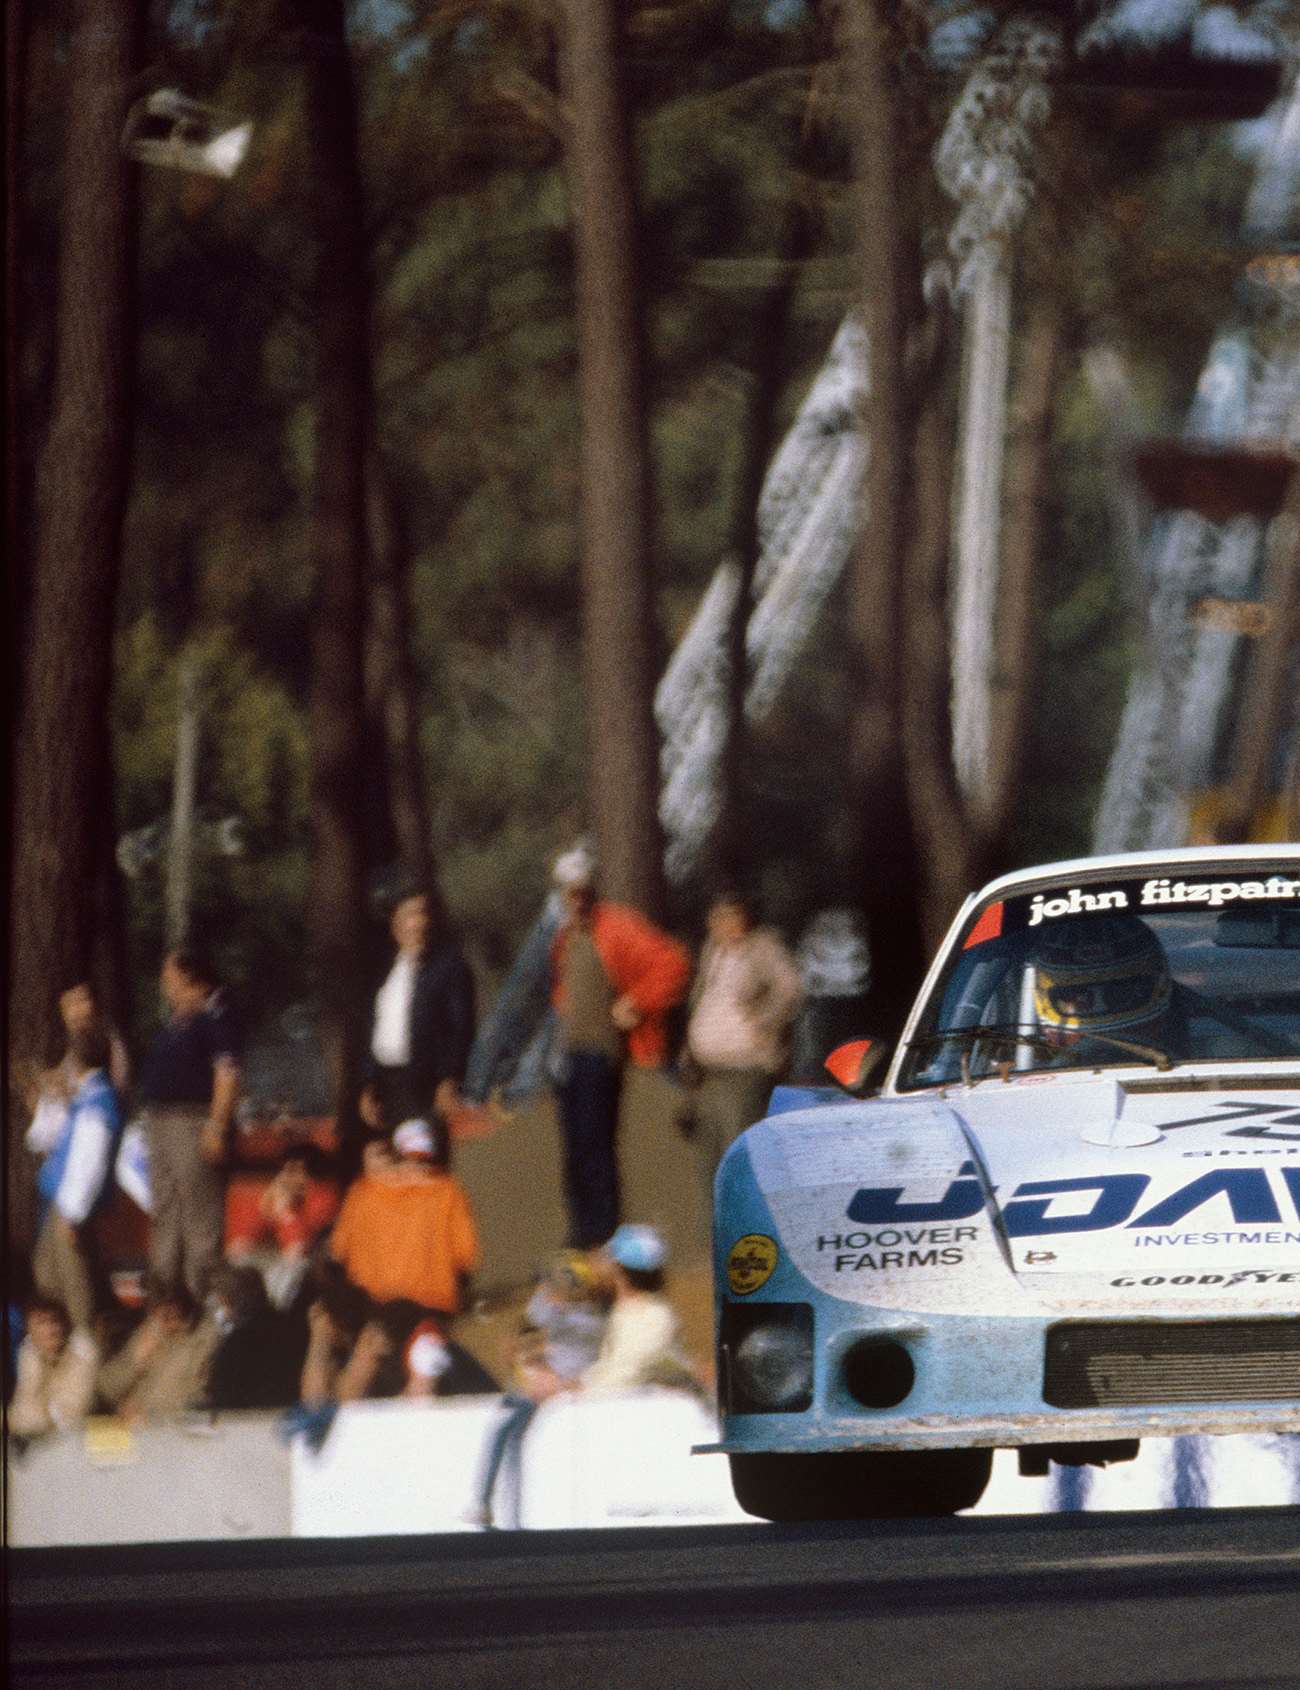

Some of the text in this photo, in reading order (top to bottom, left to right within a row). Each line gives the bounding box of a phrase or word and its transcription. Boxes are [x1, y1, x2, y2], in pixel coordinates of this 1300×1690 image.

[1028, 889, 1128, 926] john
[817, 1226, 979, 1251] HOOVER
[834, 1247, 964, 1272] FARMS
